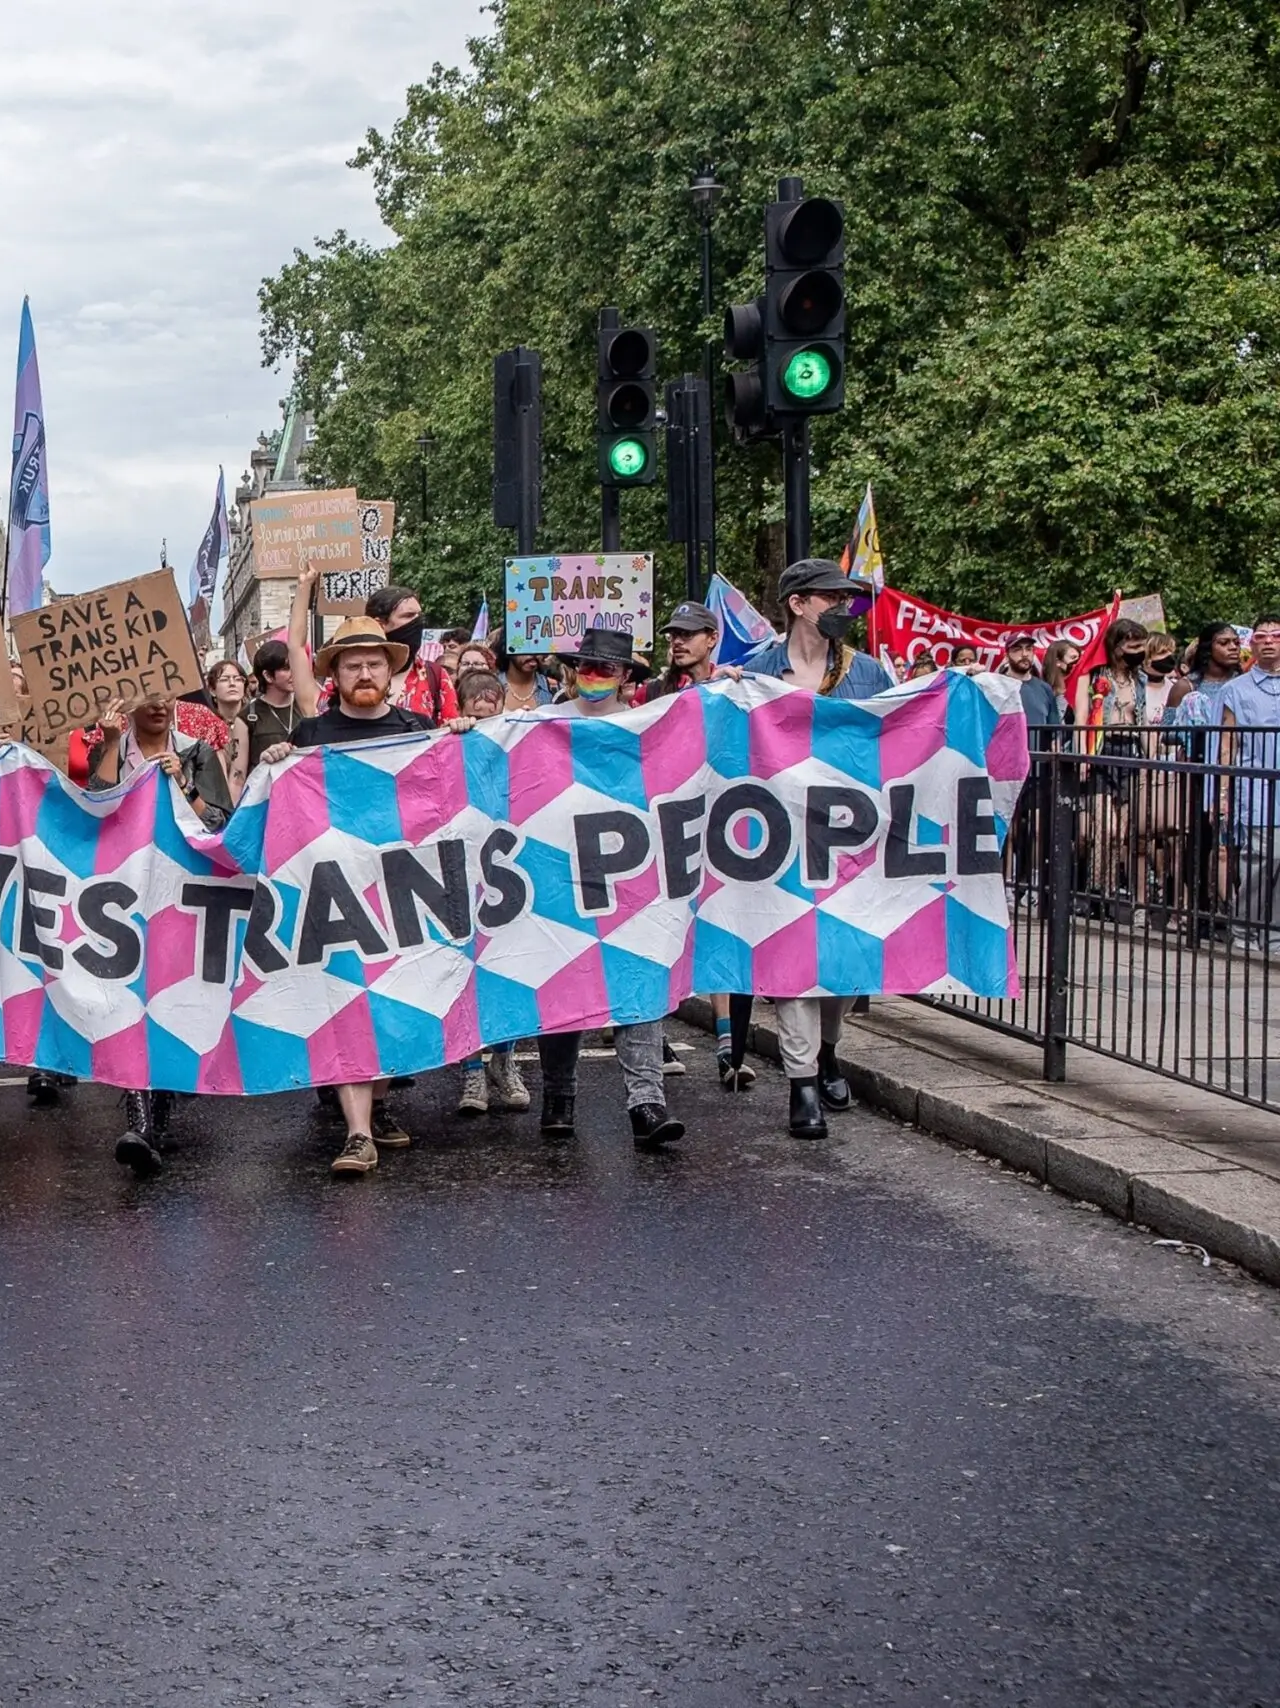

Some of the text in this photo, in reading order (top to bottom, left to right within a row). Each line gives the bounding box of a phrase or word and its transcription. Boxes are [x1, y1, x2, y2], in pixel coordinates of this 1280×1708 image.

[258, 548, 292, 566] ONLY
[528, 575, 624, 601] TRANS
[28, 609, 168, 667] TRANS KID
[38, 591, 145, 640] SAVE A
[897, 600, 974, 641] FEAR
[49, 639, 169, 691] SMASH A
[42, 660, 185, 730] BORDER
[181, 827, 527, 984] TRANS
[572, 776, 1002, 911] PEOPLE
